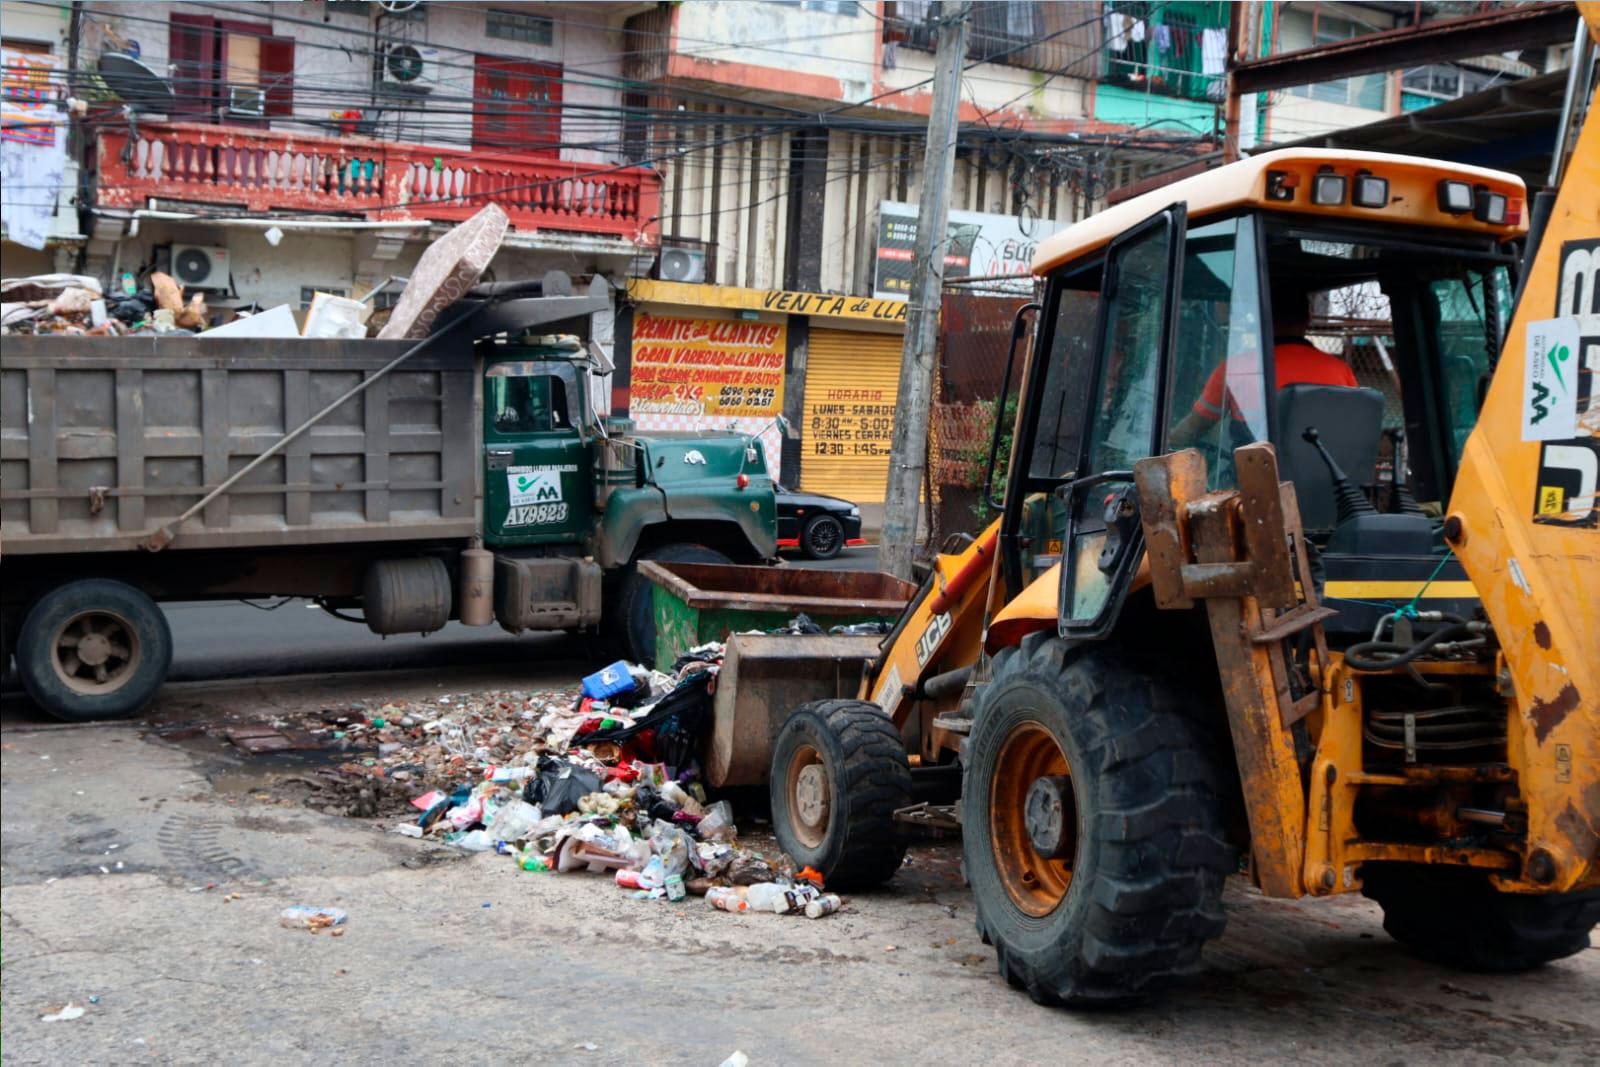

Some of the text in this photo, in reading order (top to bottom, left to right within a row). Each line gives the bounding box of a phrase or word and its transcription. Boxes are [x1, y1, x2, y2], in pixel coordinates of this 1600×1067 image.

[765, 291, 845, 315] VENTA
[850, 299, 868, 312] de
[632, 315, 694, 341] REMATE
[708, 322, 780, 347] LLANTAS
[636, 346, 672, 364] GRAN
[735, 351, 784, 369] LLANTAS
[827, 389, 882, 401] HORARIO
[813, 429, 852, 440] VIERNES
[503, 502, 568, 528] AY9823
[918, 610, 953, 667] JCB
